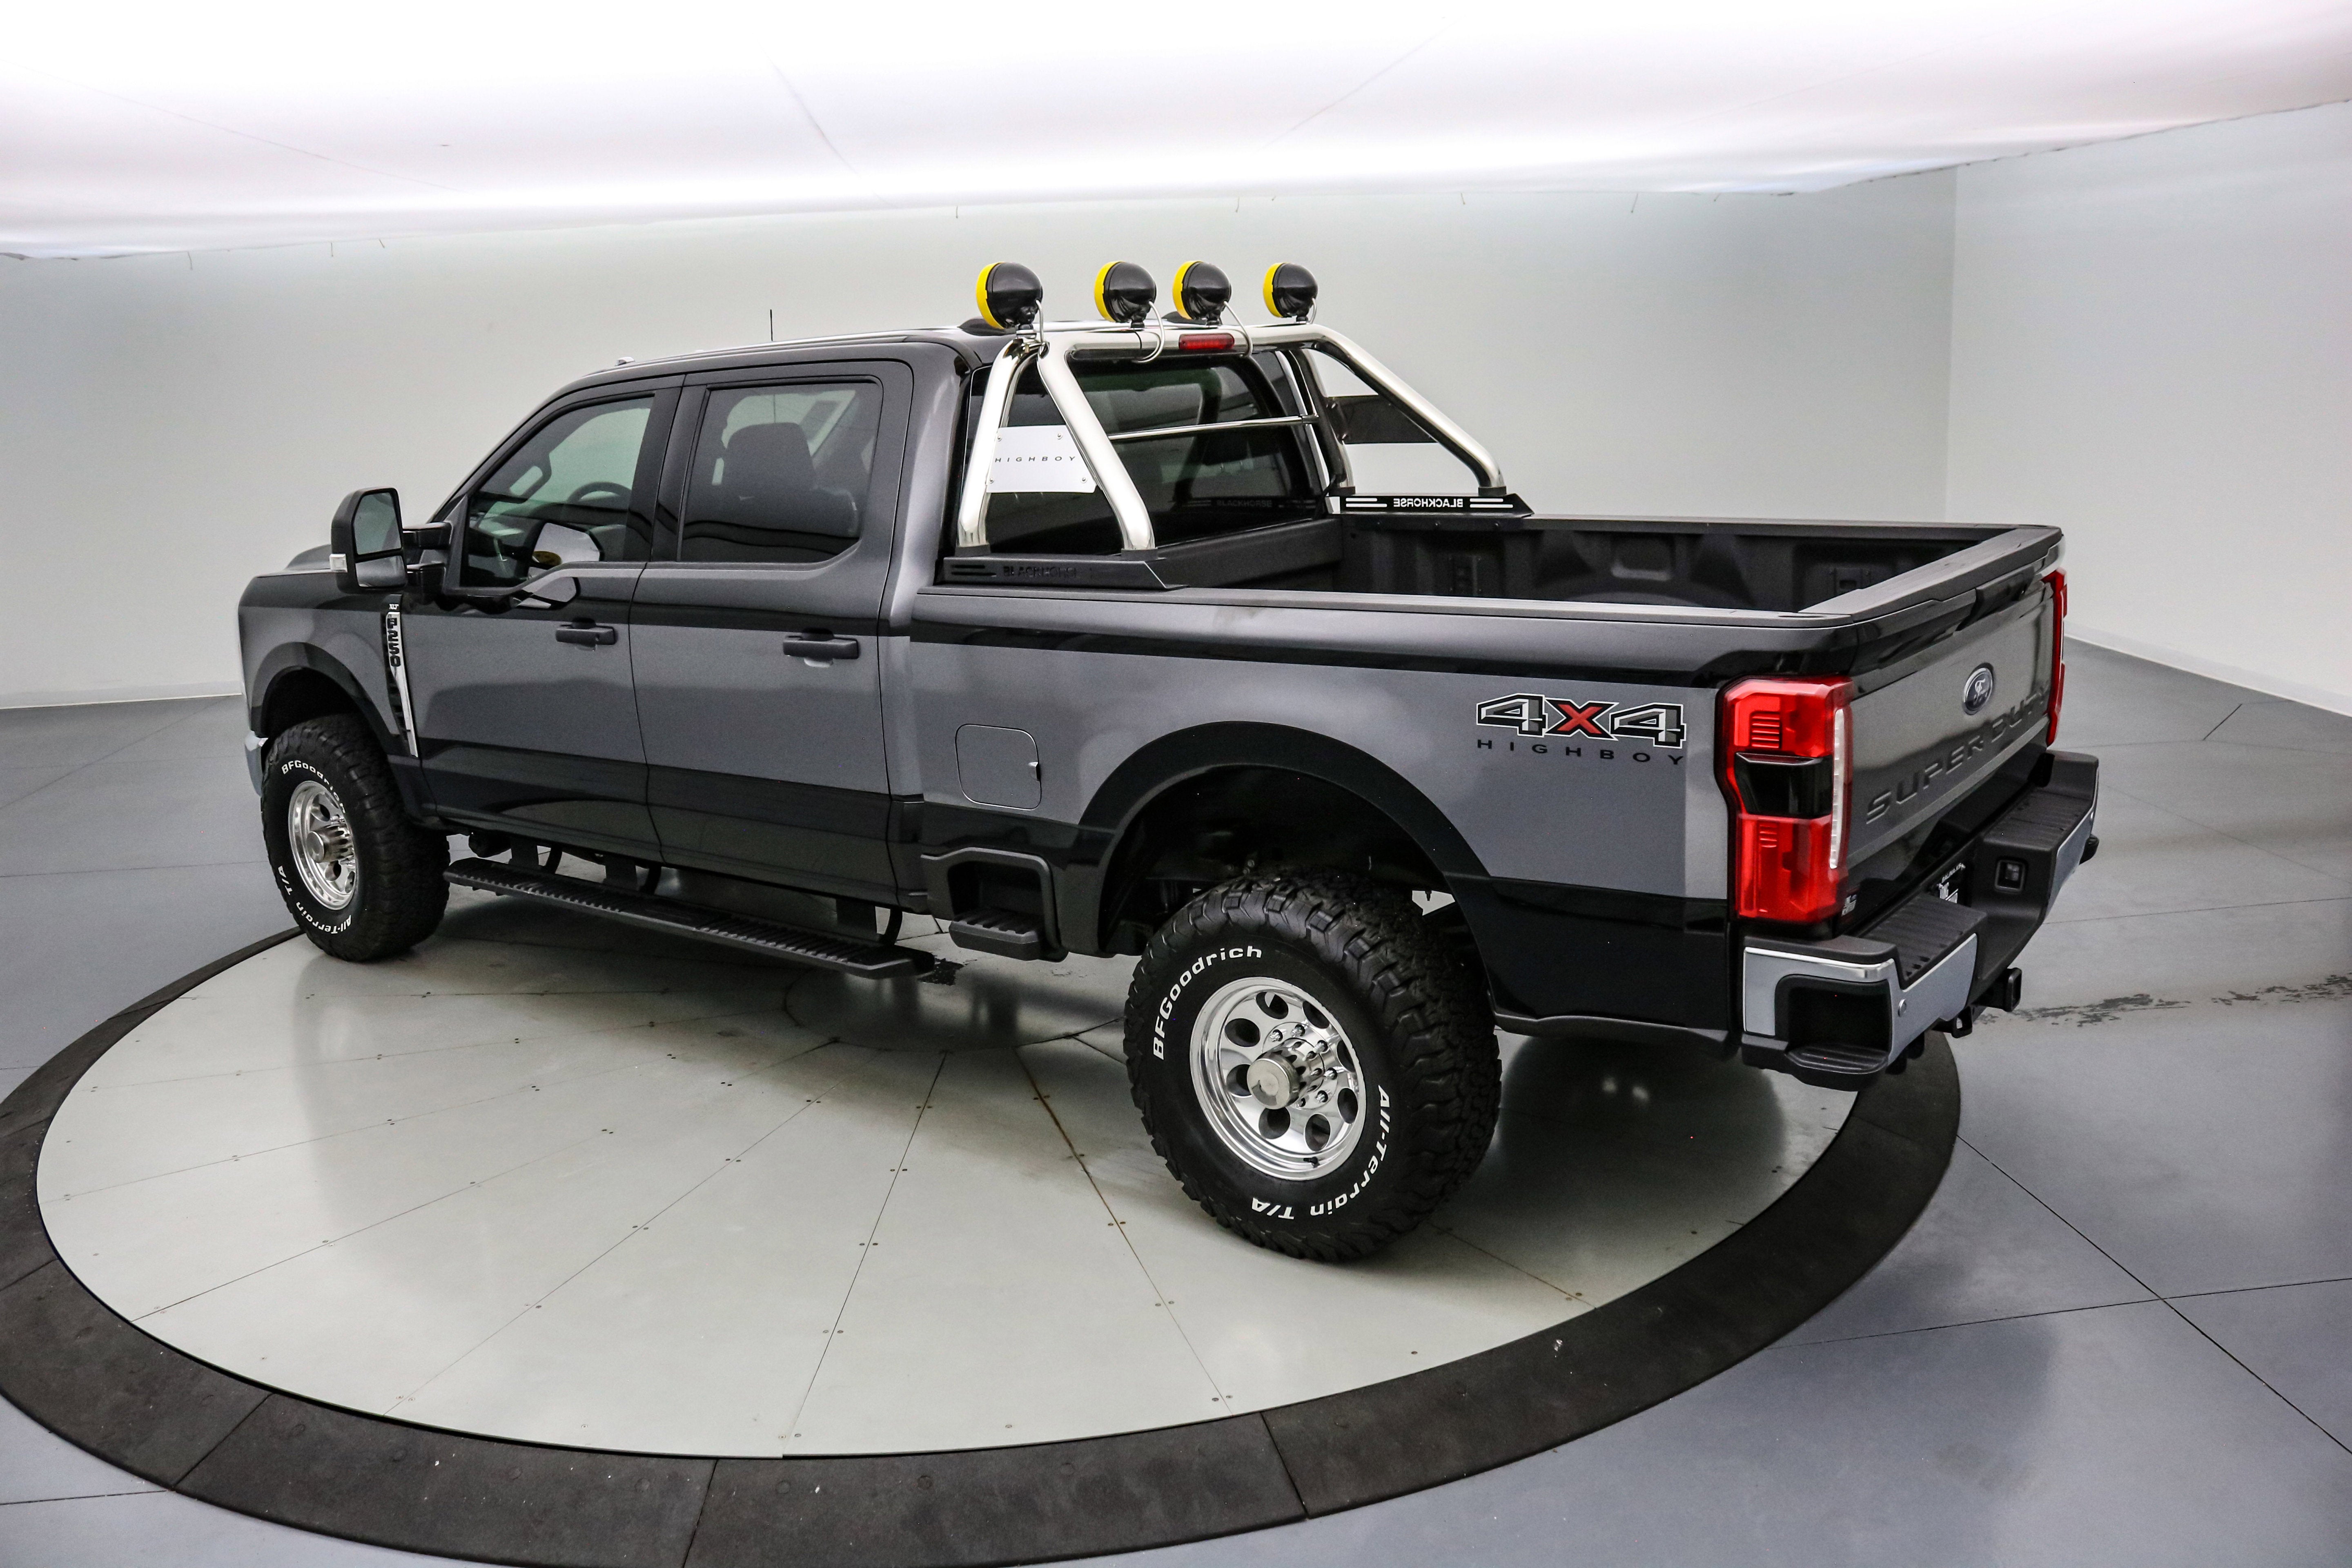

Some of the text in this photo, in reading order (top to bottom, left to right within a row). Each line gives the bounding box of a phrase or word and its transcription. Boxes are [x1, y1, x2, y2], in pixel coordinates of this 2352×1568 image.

[281, 760, 346, 813] BFGoodrich
[1477, 739, 1684, 765] HIGHBOY
[1866, 732, 1984, 824] SUPER
[278, 865, 352, 934] All-Terrain T/A
[1153, 945, 1262, 1060] BFGoodrich
[1251, 1085, 1390, 1220] All-Terrain T/A
